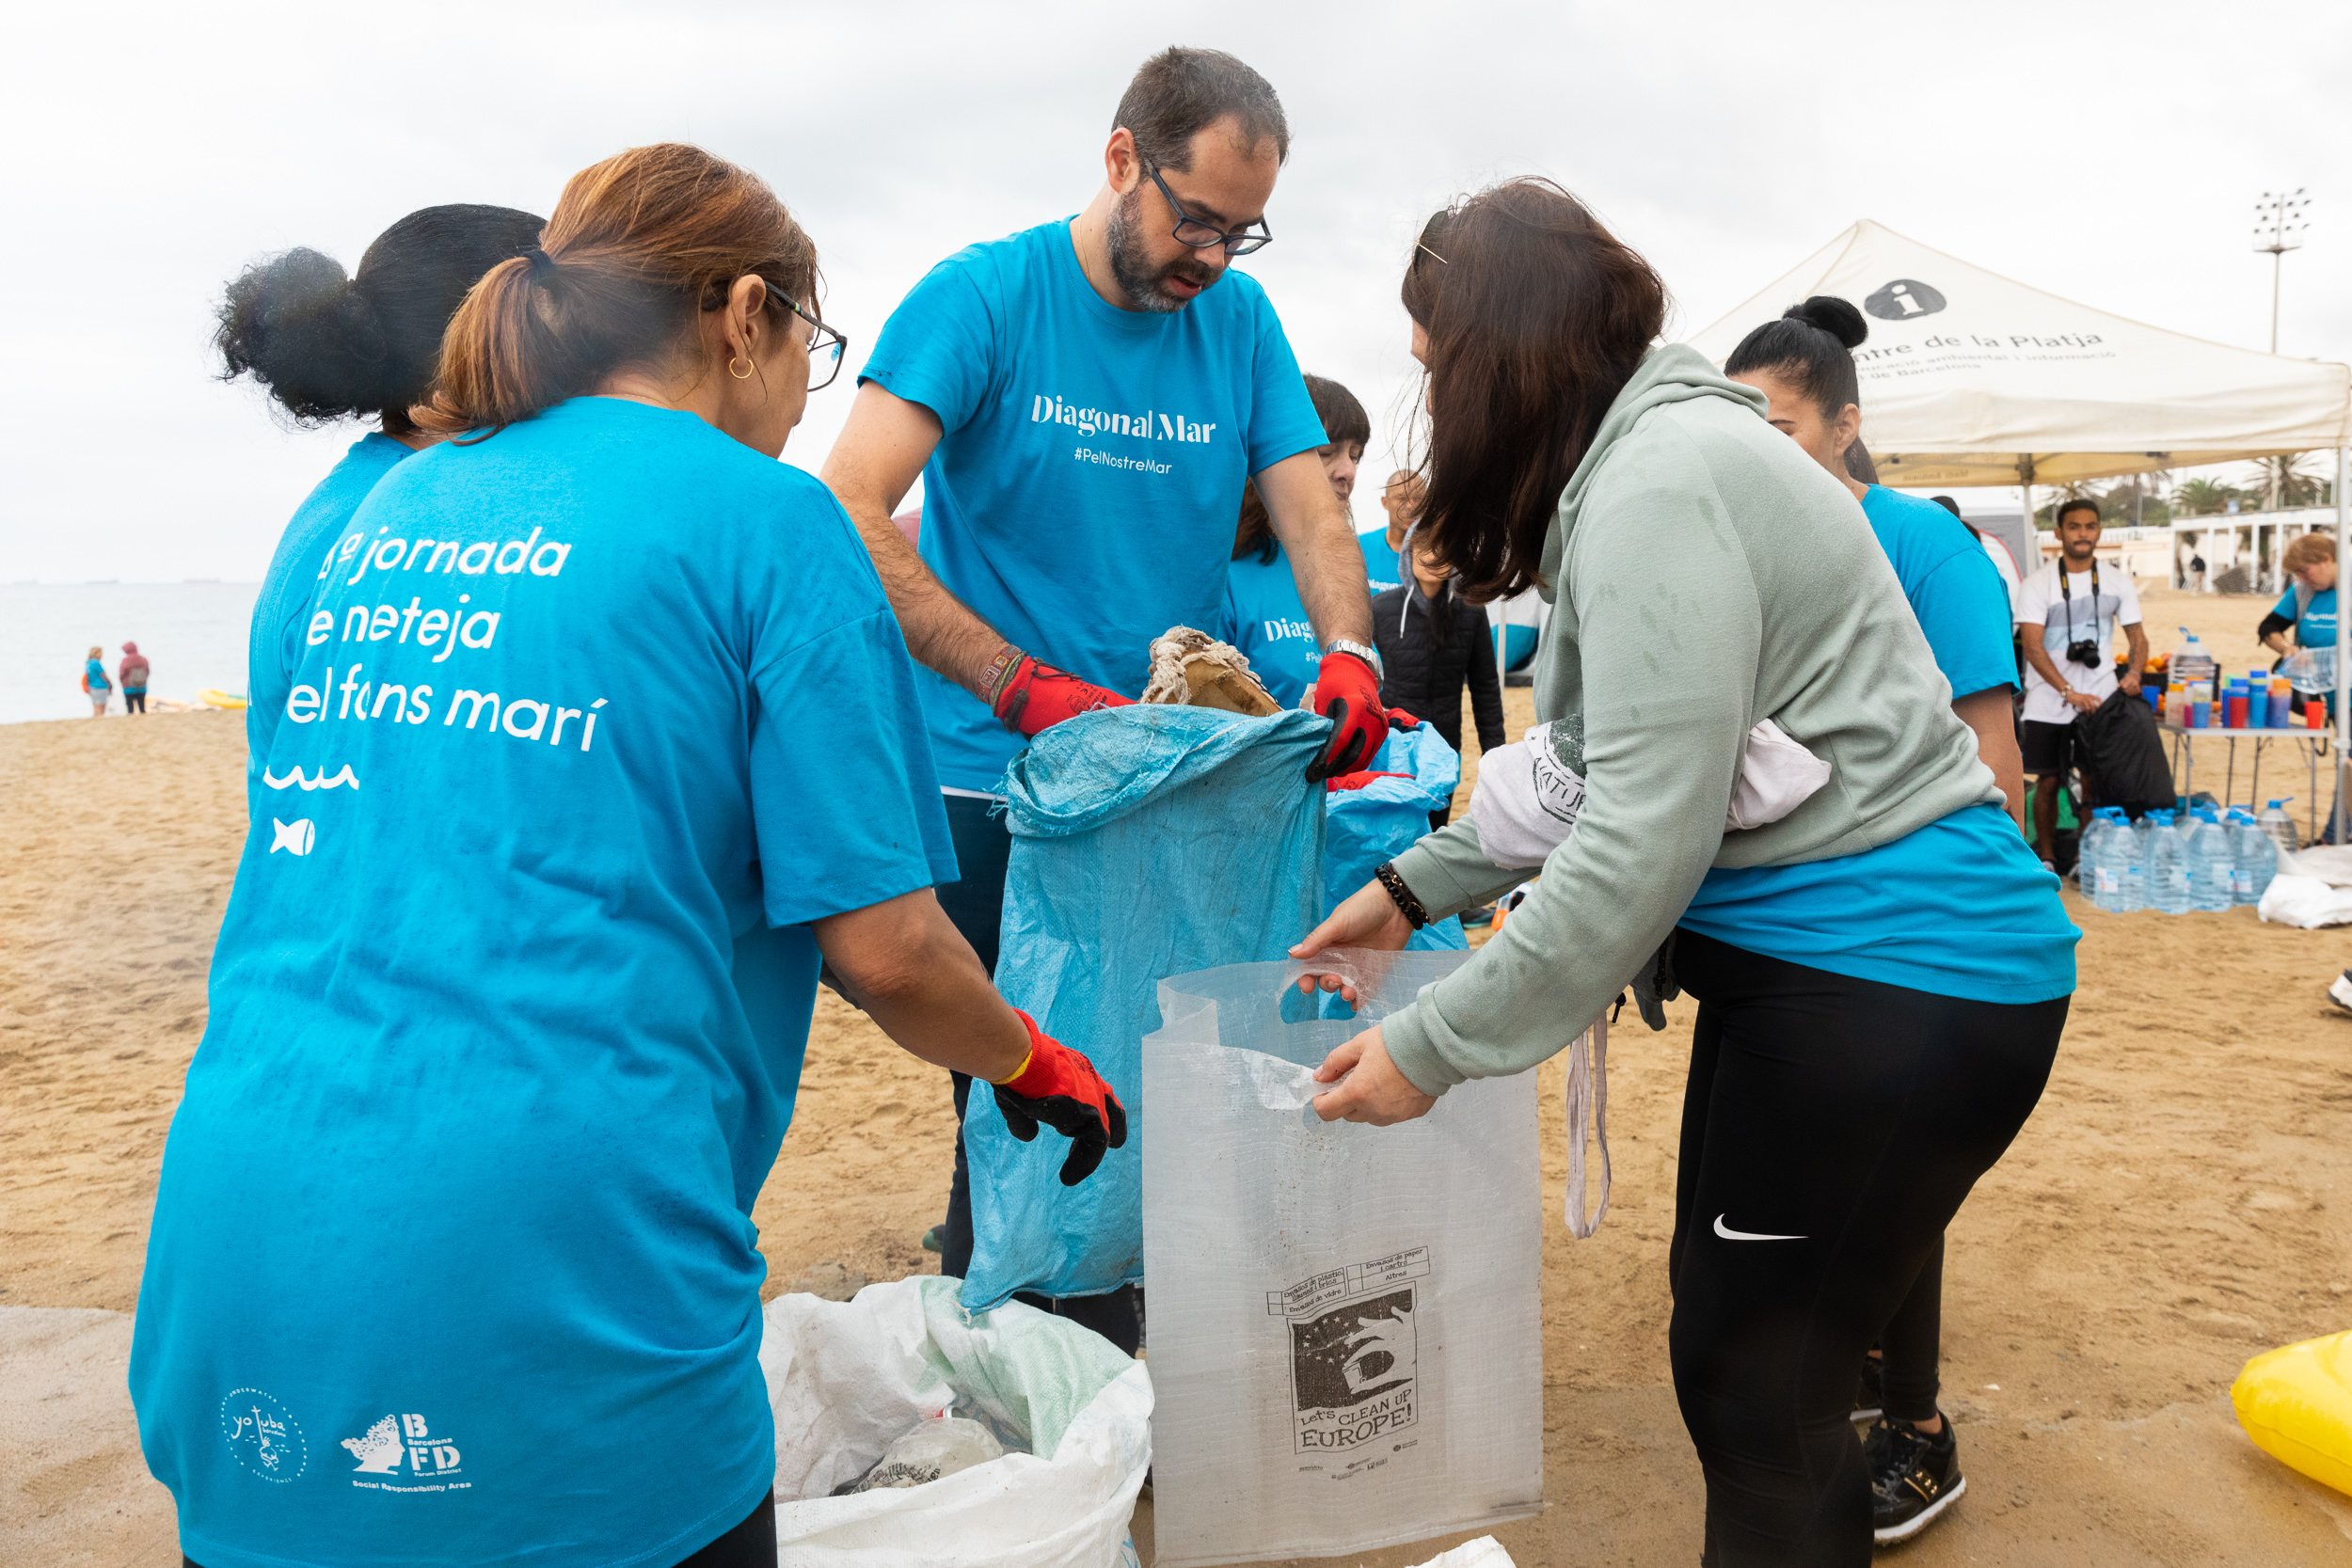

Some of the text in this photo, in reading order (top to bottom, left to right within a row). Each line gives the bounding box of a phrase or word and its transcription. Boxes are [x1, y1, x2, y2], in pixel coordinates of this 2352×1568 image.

[1925, 335, 1962, 348] de
[1970, 335, 2000, 347] la
[2010, 333, 2103, 348] Platja
[1031, 395, 1216, 444] Diagonal Mar
[1074, 447, 1172, 475] #PelNostreMar
[347, 526, 572, 585] jornada
[307, 594, 501, 662] e neteja
[1264, 618, 1315, 643] Diag
[444, 689, 609, 752] marí
[1338, 1398, 1390, 1425] CLEAN
[1394, 1388, 1412, 1405] UP
[402, 1414, 428, 1437] B
[1301, 1402, 1412, 1447] EUROPE!
[407, 1437, 453, 1446] Barcelona
[353, 1480, 379, 1489] Social
[381, 1482, 445, 1493] Responsibility
